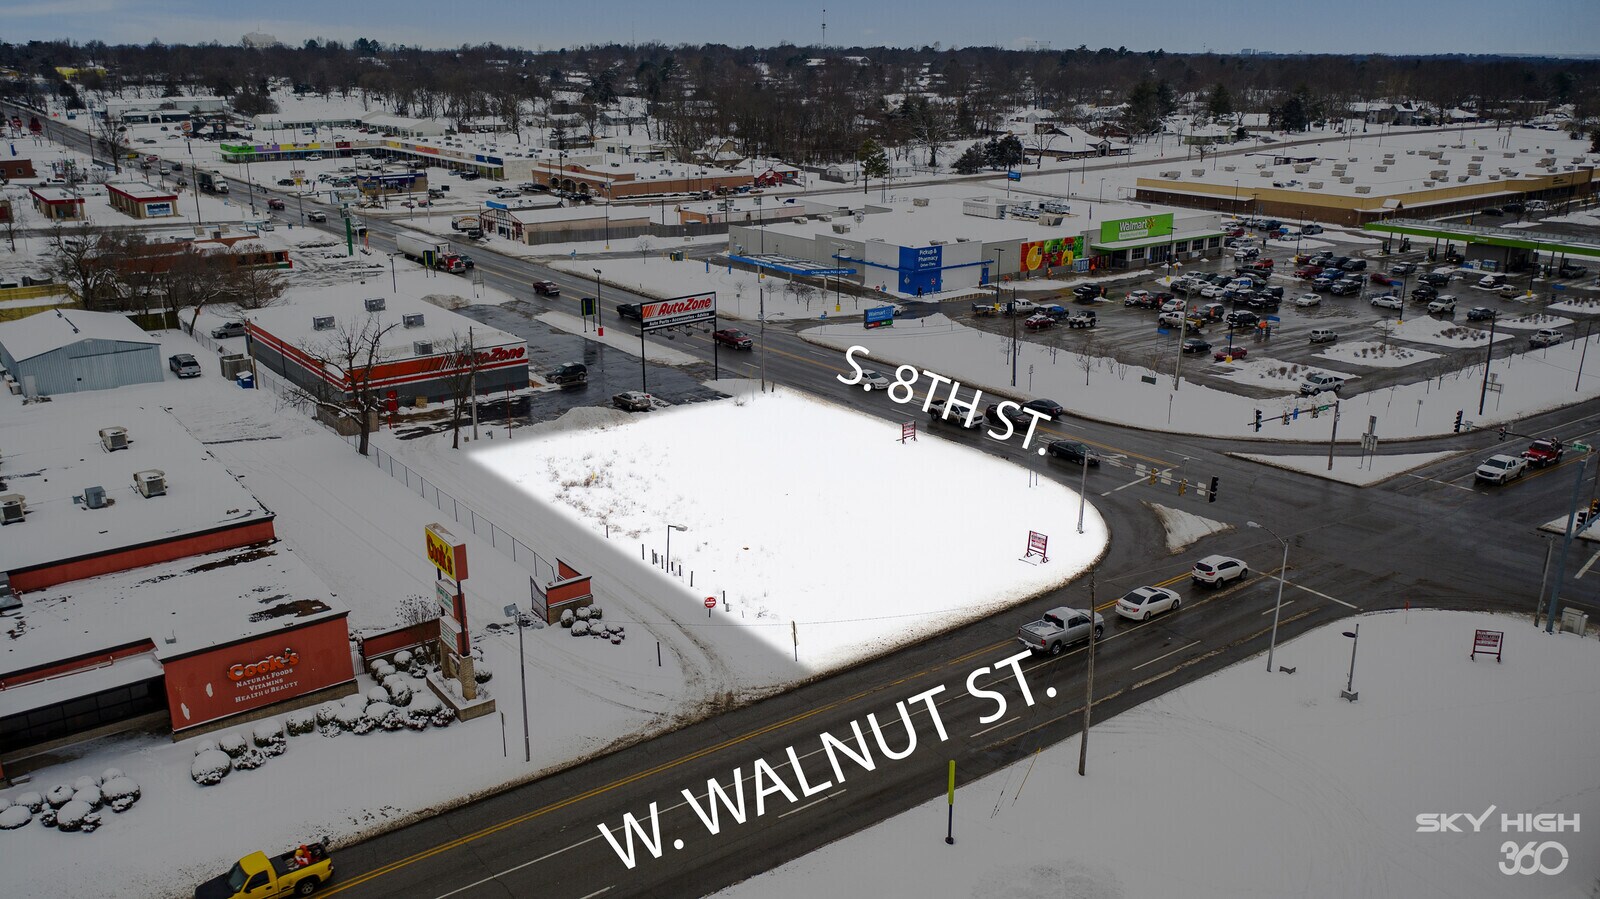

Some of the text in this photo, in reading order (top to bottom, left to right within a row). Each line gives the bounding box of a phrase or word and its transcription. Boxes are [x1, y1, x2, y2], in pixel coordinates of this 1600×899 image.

[1120, 219, 1147, 231] Walmart
[918, 255, 938, 263] Pharmacy
[658, 297, 711, 316] AutoZone
[455, 346, 525, 368] AutoZone
[427, 533, 453, 576] Cook's
[227, 648, 300, 681] Cook's
[236, 668, 293, 687] NATURAL FOODS
[249, 678, 284, 691] VITAMINS
[235, 690, 264, 703] HEALTH
[271, 681, 299, 693] BEAUTY
